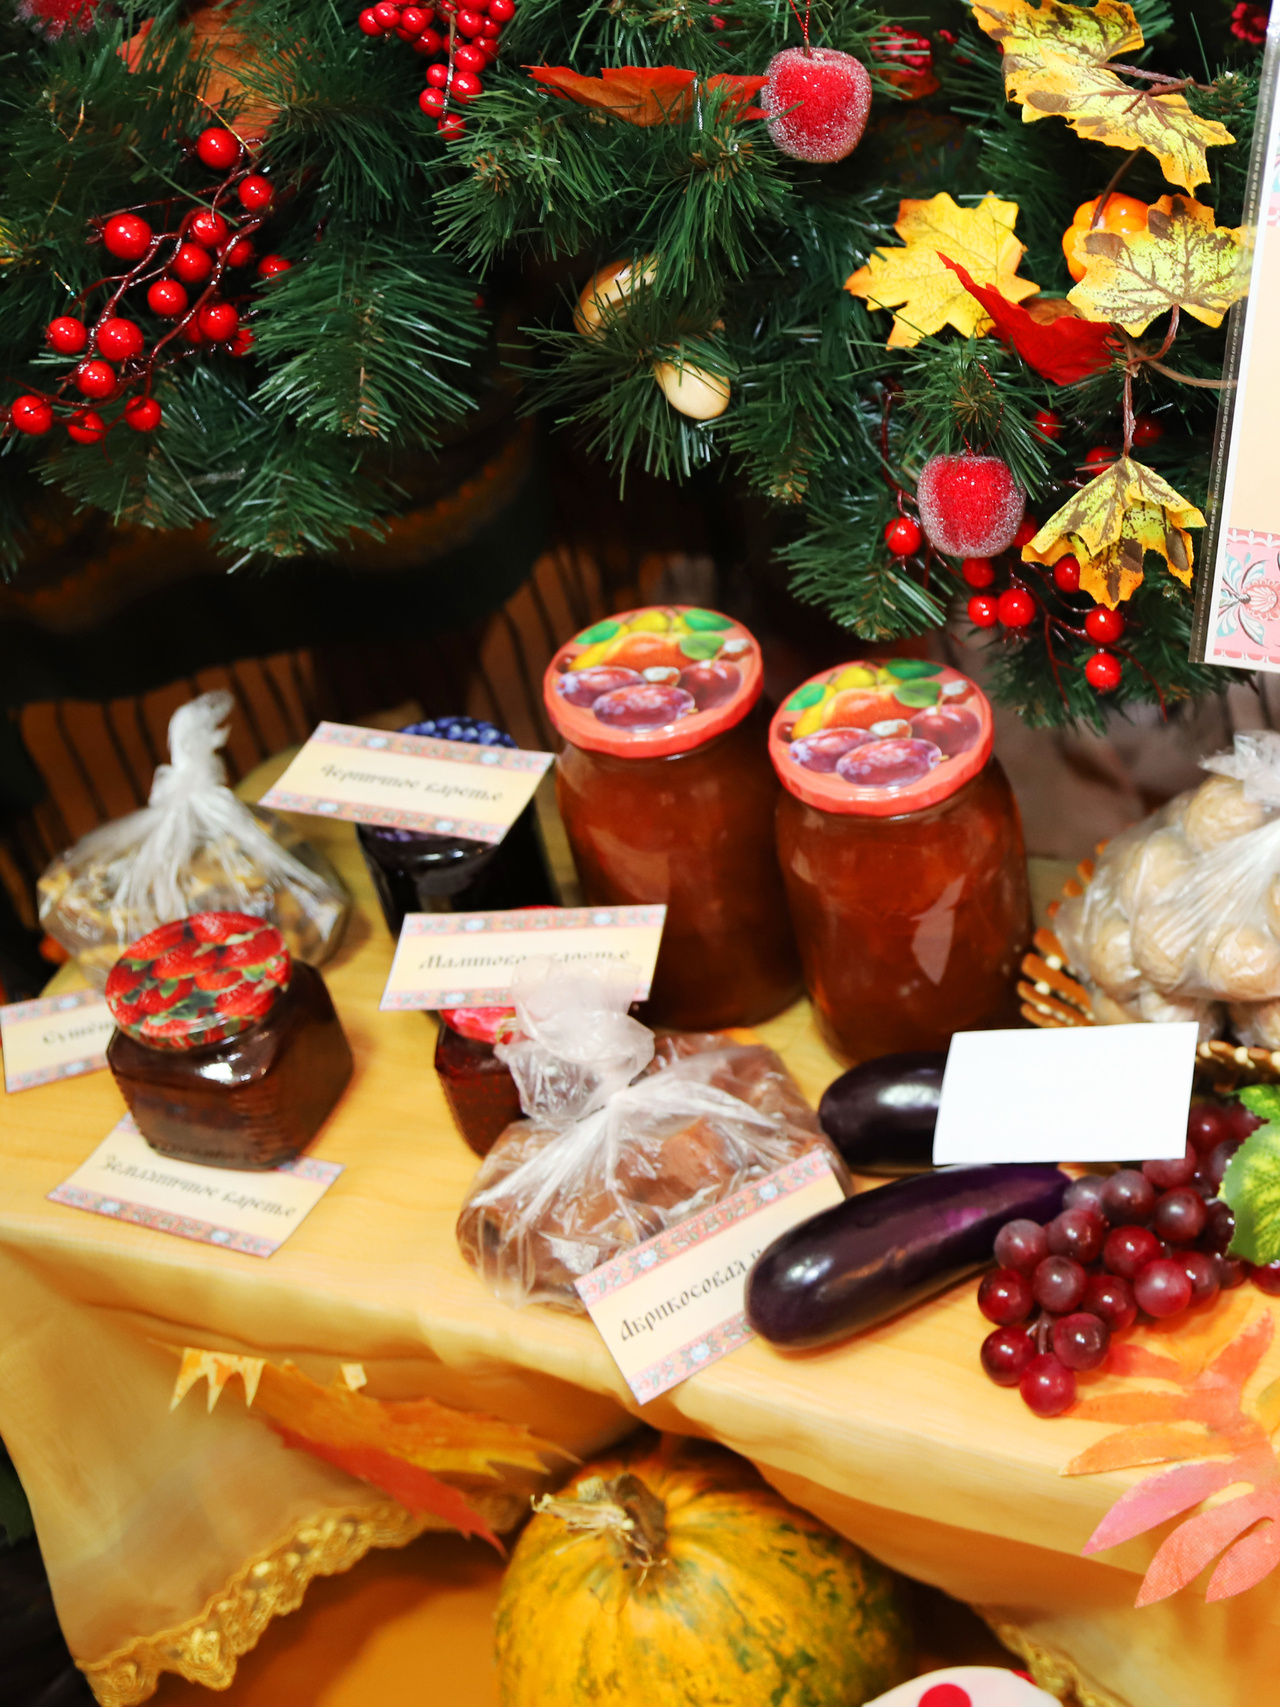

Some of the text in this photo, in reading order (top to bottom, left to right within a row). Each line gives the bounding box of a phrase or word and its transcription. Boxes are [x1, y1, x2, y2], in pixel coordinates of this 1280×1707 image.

[424, 780, 504, 802] варенье
[418, 953, 530, 970] Малиново
[42, 1021, 117, 1045] Сушён
[222, 1190, 298, 1218] варенье
[620, 1258, 748, 1343] Абрикосовая
